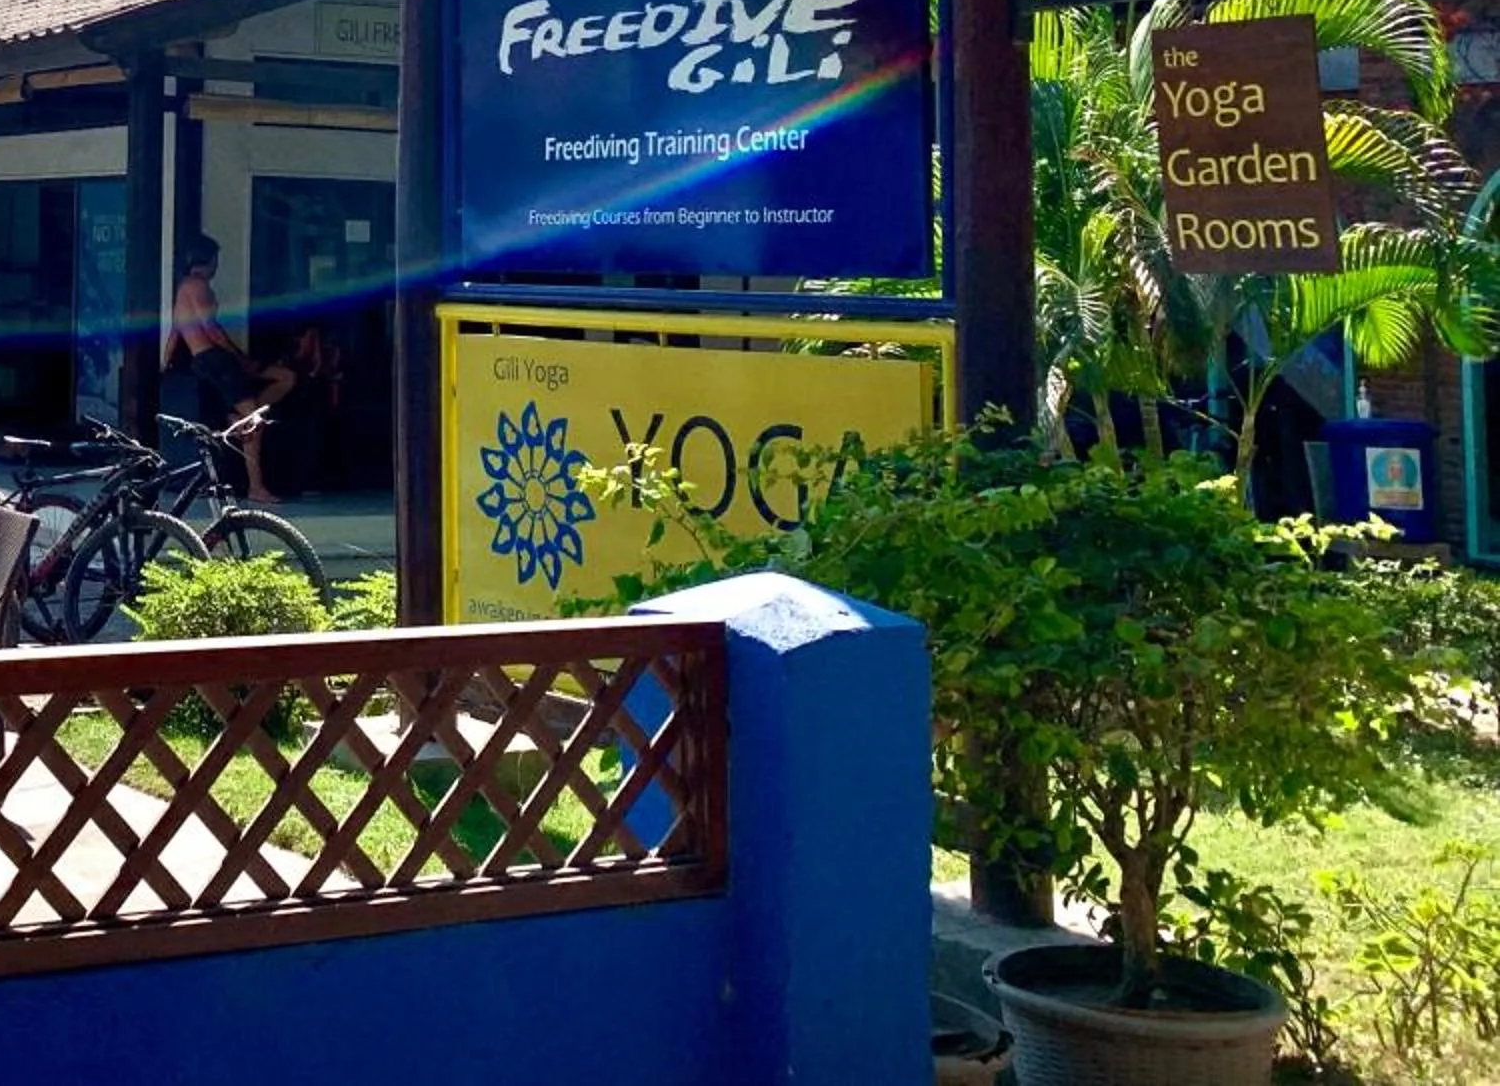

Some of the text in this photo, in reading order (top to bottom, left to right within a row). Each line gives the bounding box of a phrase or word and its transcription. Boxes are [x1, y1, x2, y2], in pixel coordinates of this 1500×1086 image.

[1163, 46, 1199, 67] the
[1161, 80, 1266, 128] Yoga
[544, 125, 809, 164] Freediving Training Center
[1166, 142, 1317, 187] Garden
[528, 206, 835, 229] Freediving Courses from Beginner to Instructor
[1175, 212, 1321, 251] Rooms
[493, 356, 569, 391] Gili Yoga
